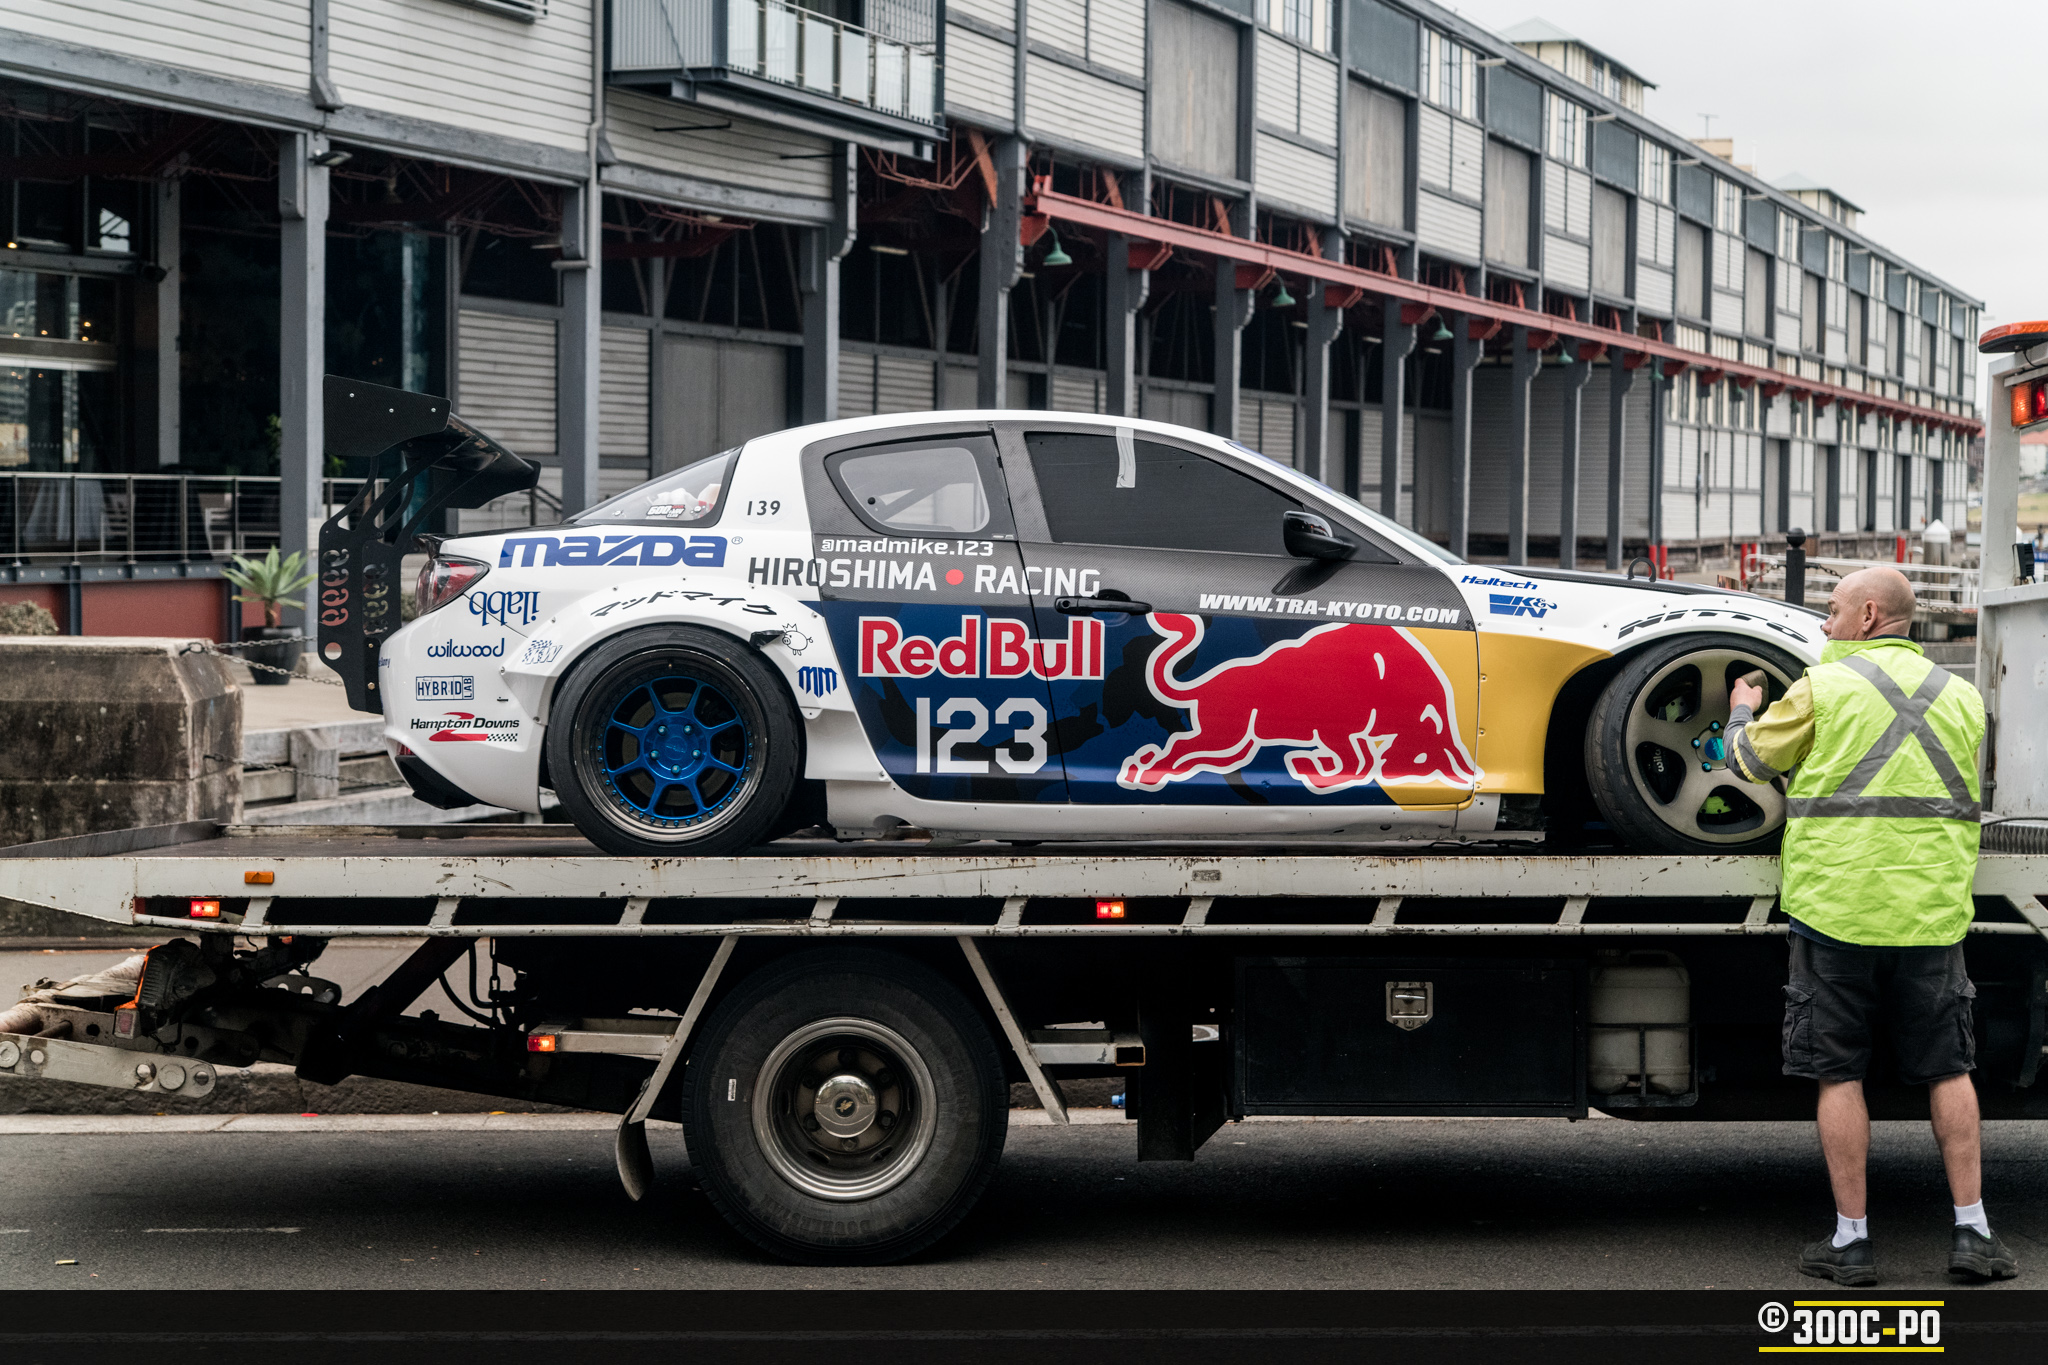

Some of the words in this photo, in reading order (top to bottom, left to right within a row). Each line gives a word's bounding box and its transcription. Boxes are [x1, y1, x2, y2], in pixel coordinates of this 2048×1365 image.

[747, 500, 781, 517] 139
[821, 538, 994, 556] @madmike.123
[748, 557, 937, 592] HIROSHIMA
[974, 565, 1101, 598] RACING
[1460, 575, 1538, 590] Haltech
[590, 590, 777, 616] マッドマイク
[1200, 594, 1460, 624] WWW.TRA-KYOTO.COM
[1508, 595, 1557, 618] K&N
[1618, 609, 1809, 643] NITTO
[427, 638, 504, 657] wilwood
[859, 616, 980, 678] Red
[986, 616, 1105, 680] Bull
[417, 681, 462, 696] HYBRID
[463, 677, 472, 698] LAB
[410, 718, 470, 731] Hampton
[474, 718, 520, 729] Downs
[916, 697, 1048, 773] 123
